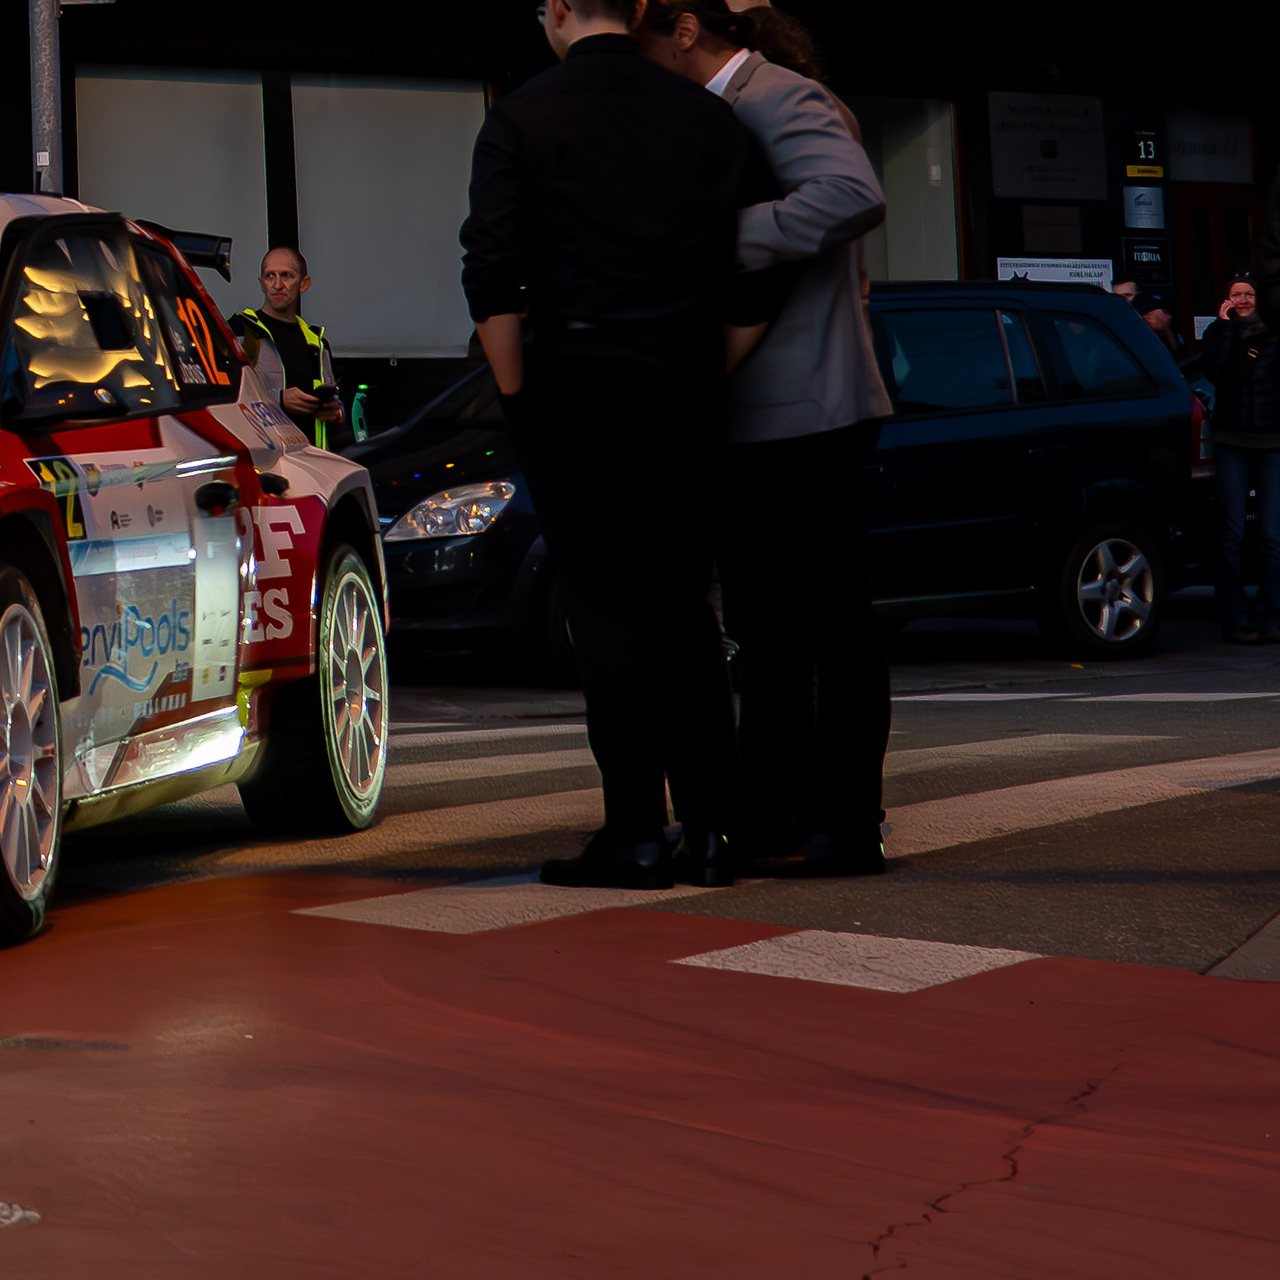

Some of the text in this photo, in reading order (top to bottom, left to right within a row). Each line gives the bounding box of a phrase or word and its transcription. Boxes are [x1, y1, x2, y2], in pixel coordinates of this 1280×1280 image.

[1137, 139, 1157, 161] 13
[175, 295, 232, 385] 12
[242, 587, 294, 644] ES
